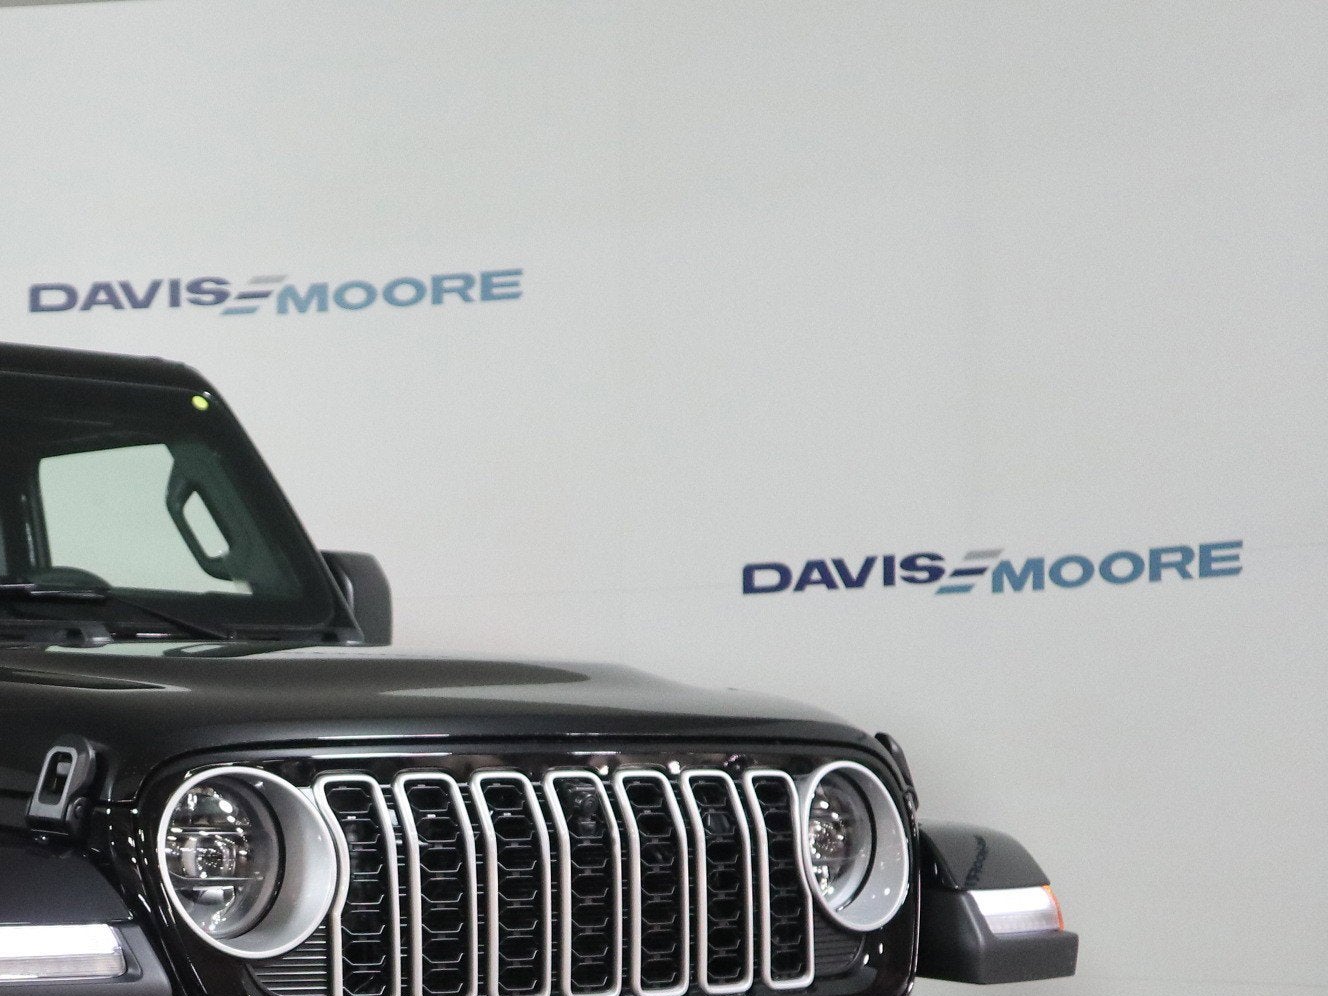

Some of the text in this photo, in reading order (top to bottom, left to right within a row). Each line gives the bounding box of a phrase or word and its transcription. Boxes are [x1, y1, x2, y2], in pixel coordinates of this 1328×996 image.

[28, 268, 524, 315] DAVIS MOORE
[742, 539, 1244, 595] DAVIS MOORE
